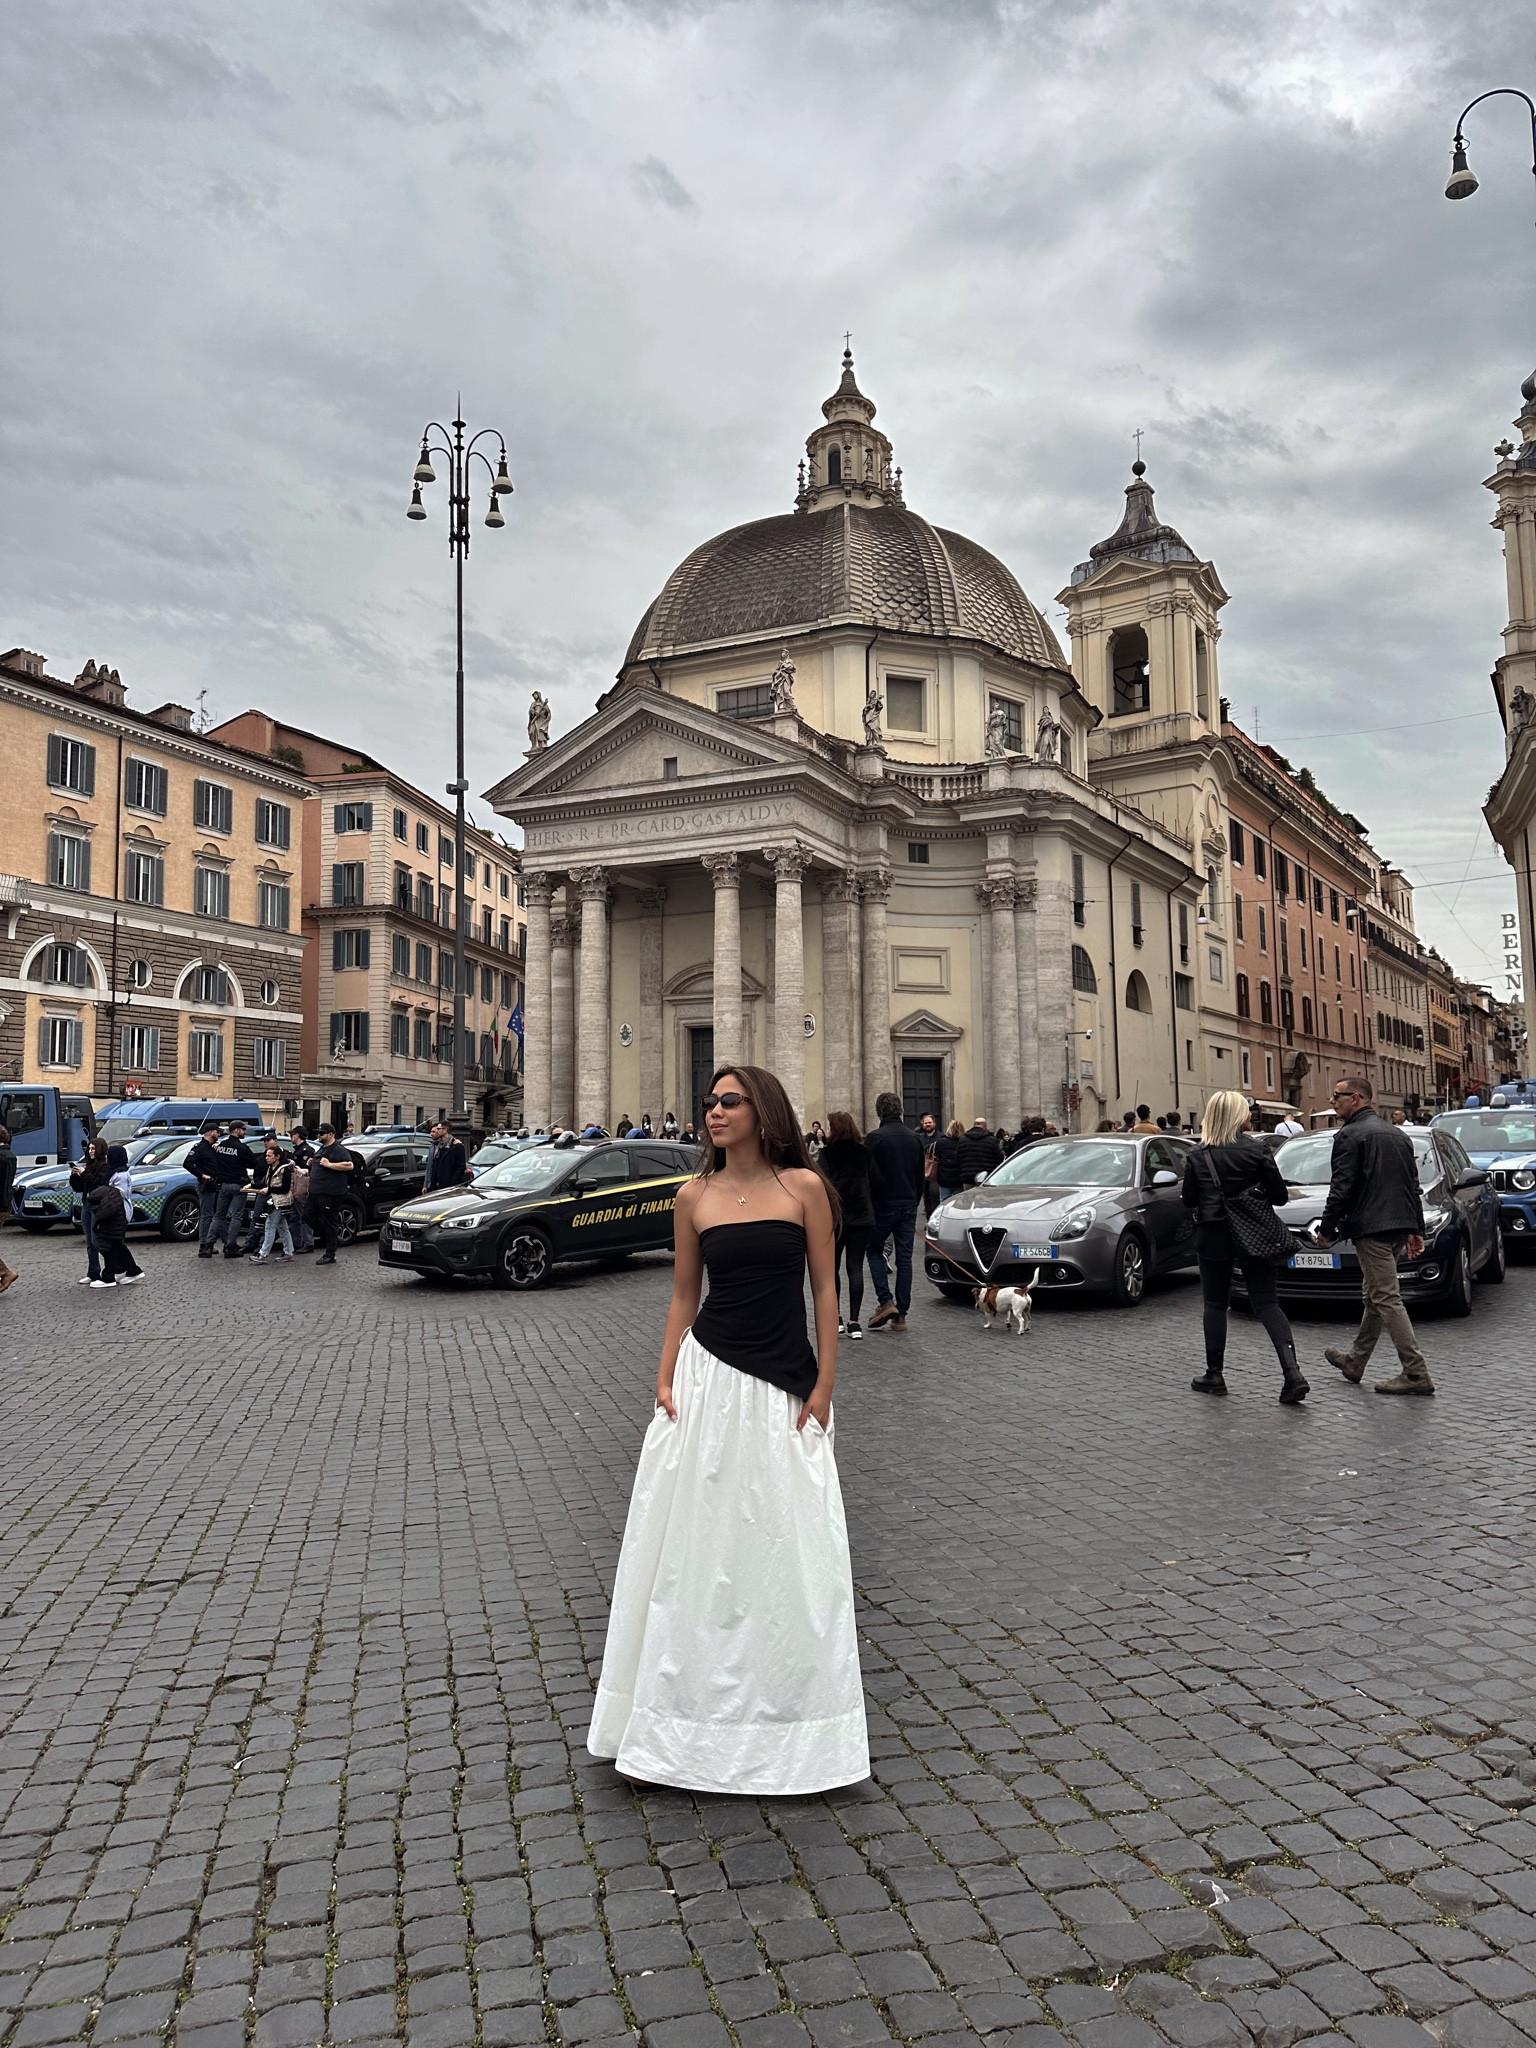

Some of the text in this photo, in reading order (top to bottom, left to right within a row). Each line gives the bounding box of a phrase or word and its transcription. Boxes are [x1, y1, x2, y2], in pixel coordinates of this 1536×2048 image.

[216, 1146, 238, 1156] POLIZIA
[572, 1198, 676, 1228] GUARDIA di FINANZ
